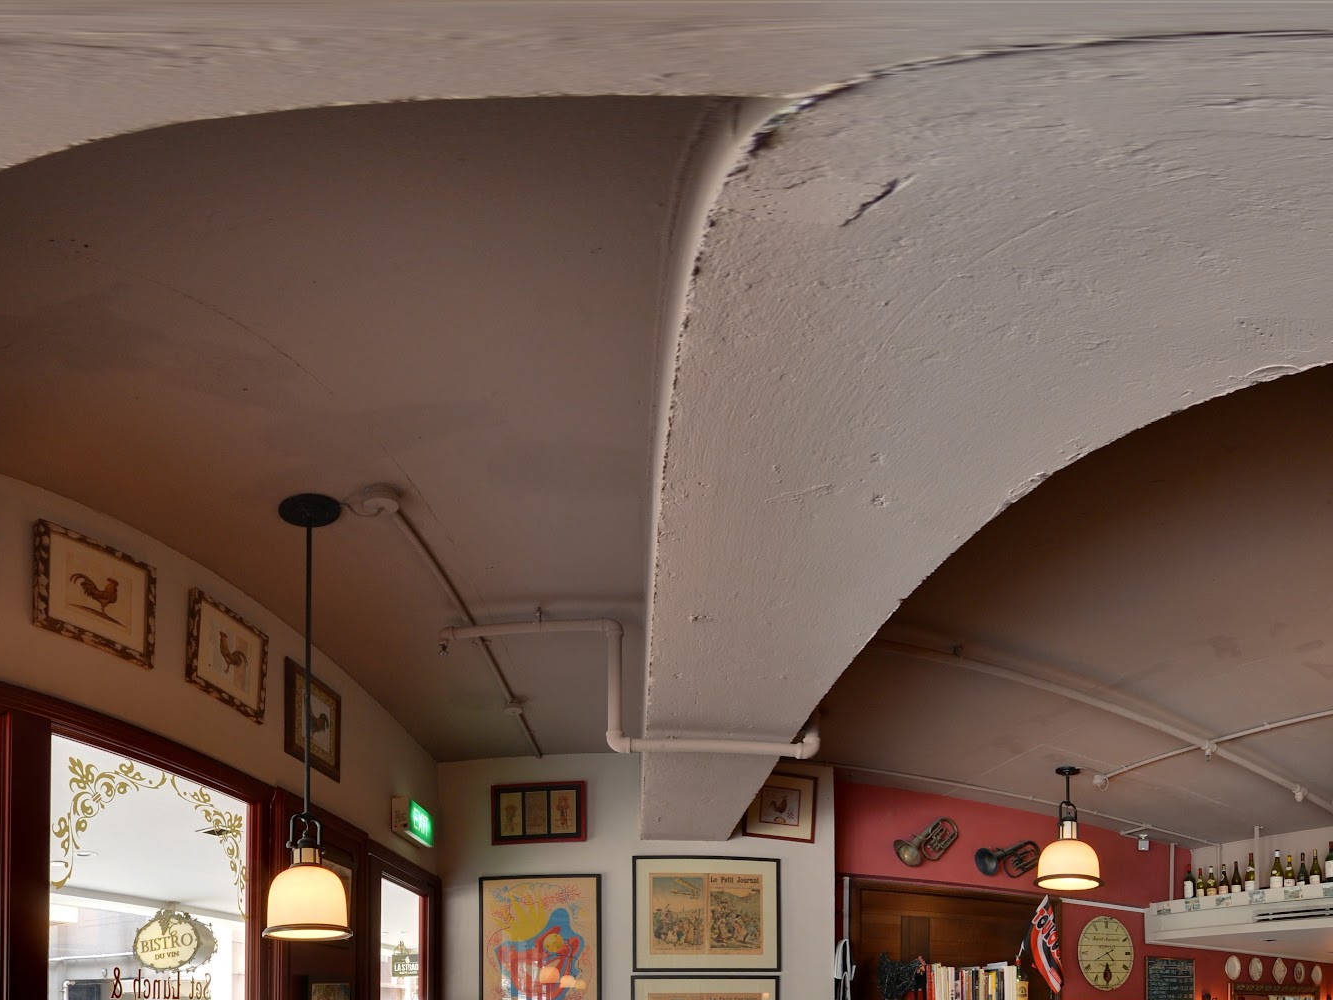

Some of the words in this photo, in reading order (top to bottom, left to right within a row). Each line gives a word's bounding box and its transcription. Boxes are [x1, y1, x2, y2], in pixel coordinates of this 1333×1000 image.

[413, 807, 429, 837] EXIT
[140, 931, 193, 954] BISTRO
[154, 953, 166, 961] DU
